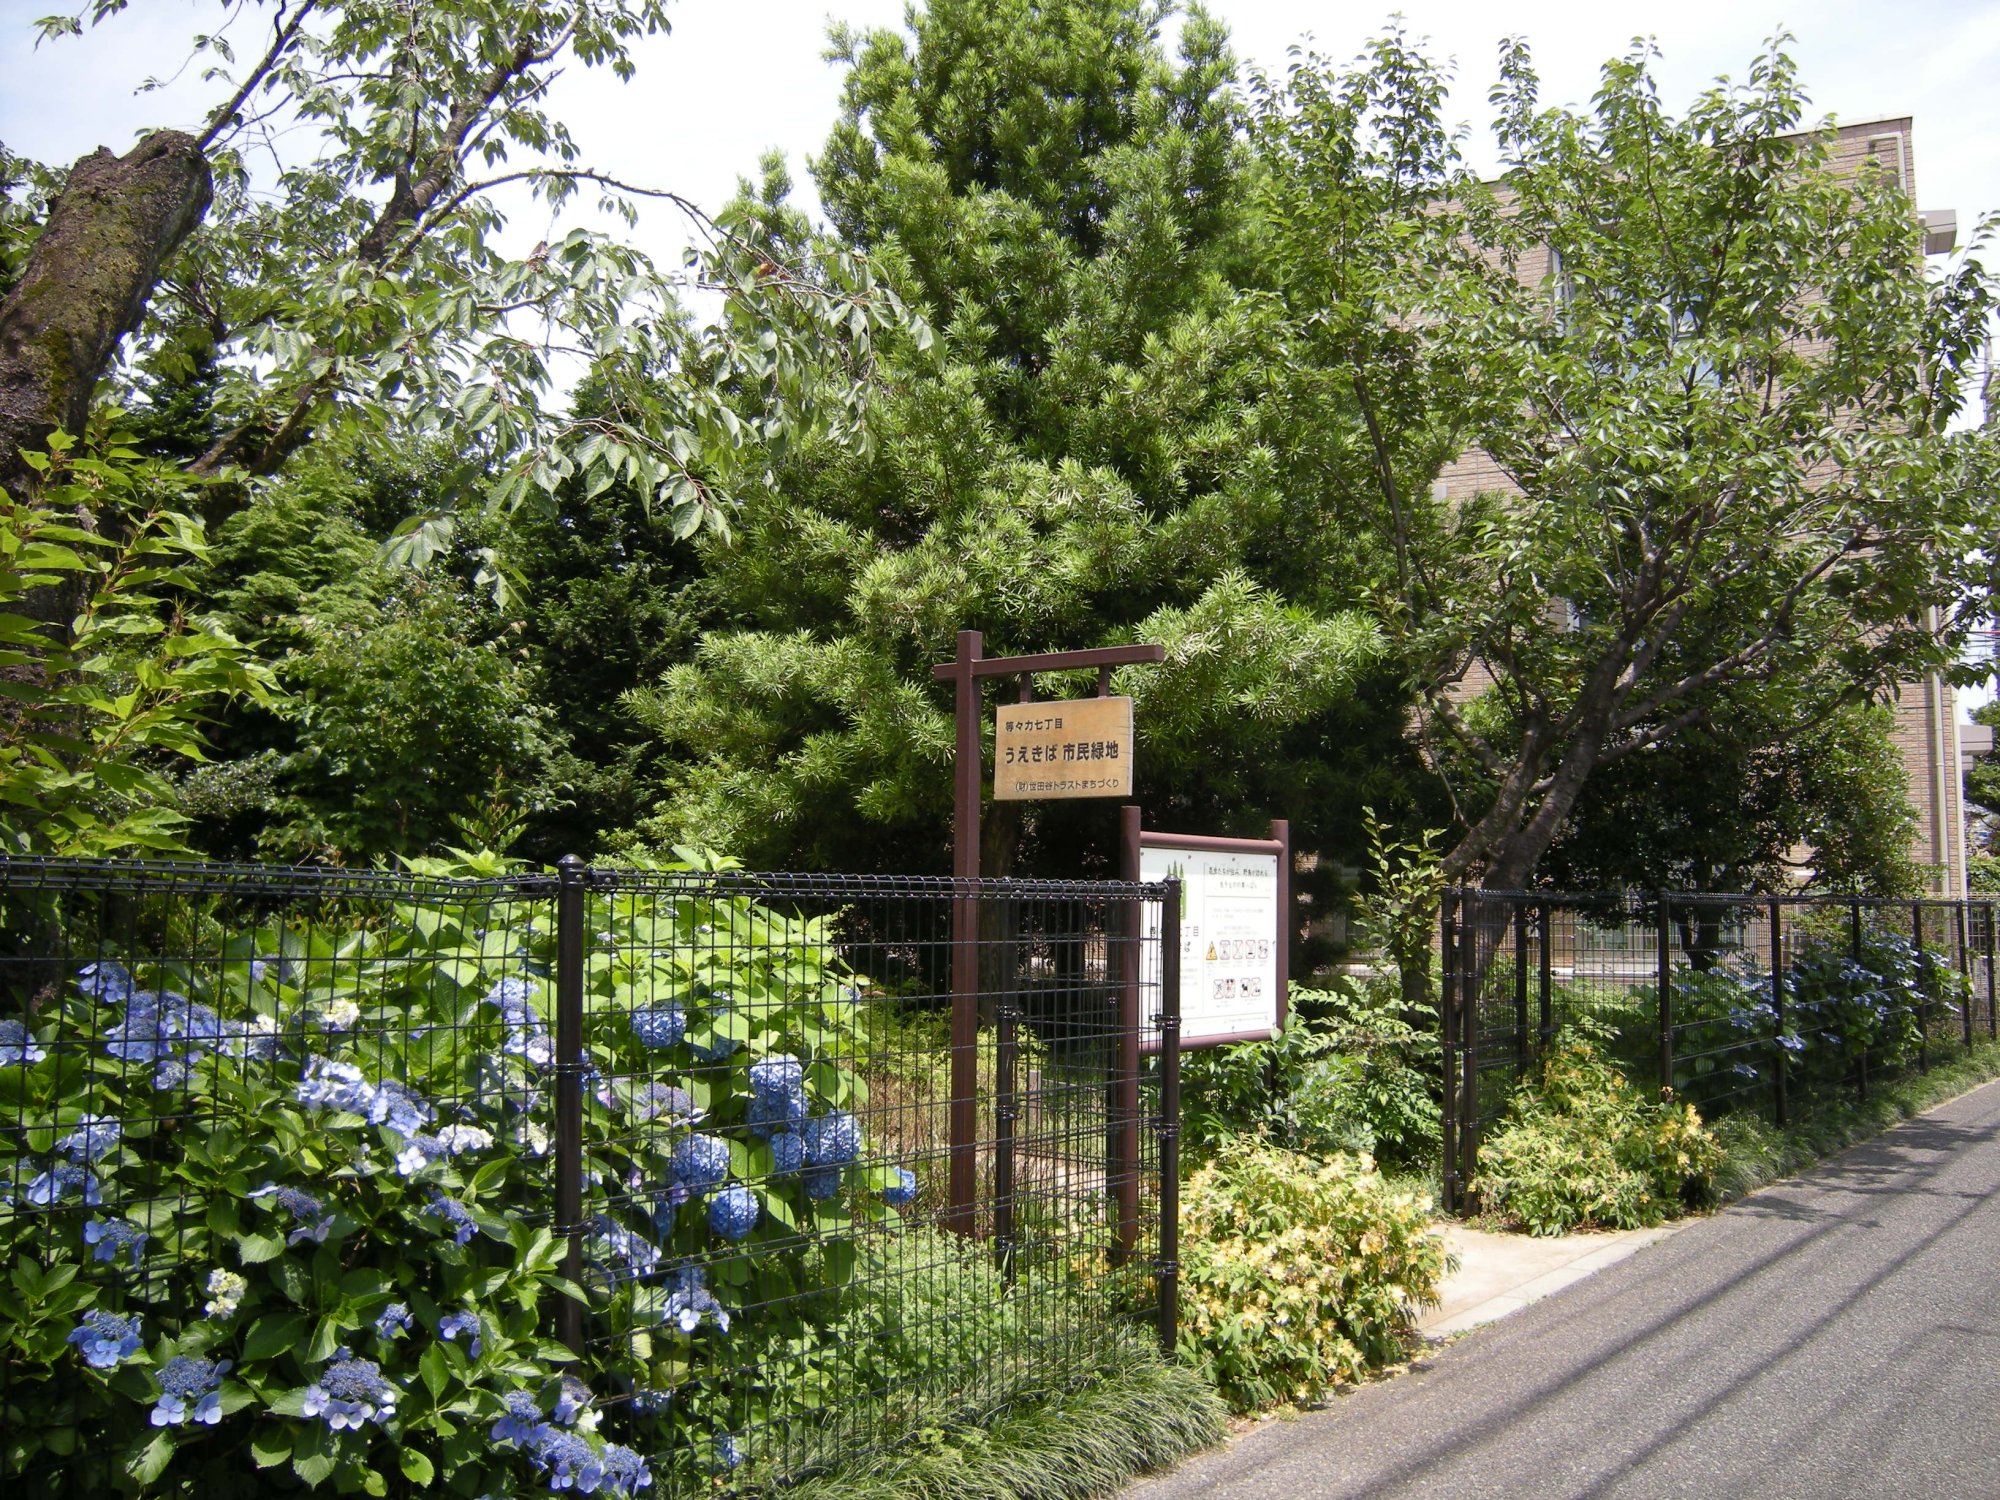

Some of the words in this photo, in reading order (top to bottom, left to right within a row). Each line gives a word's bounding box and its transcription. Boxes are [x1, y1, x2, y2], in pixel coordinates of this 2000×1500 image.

[1005, 718, 1063, 732] 等々力七丁目
[1005, 744, 1058, 764] うえきば
[1063, 740, 1119, 761] 市民緑地
